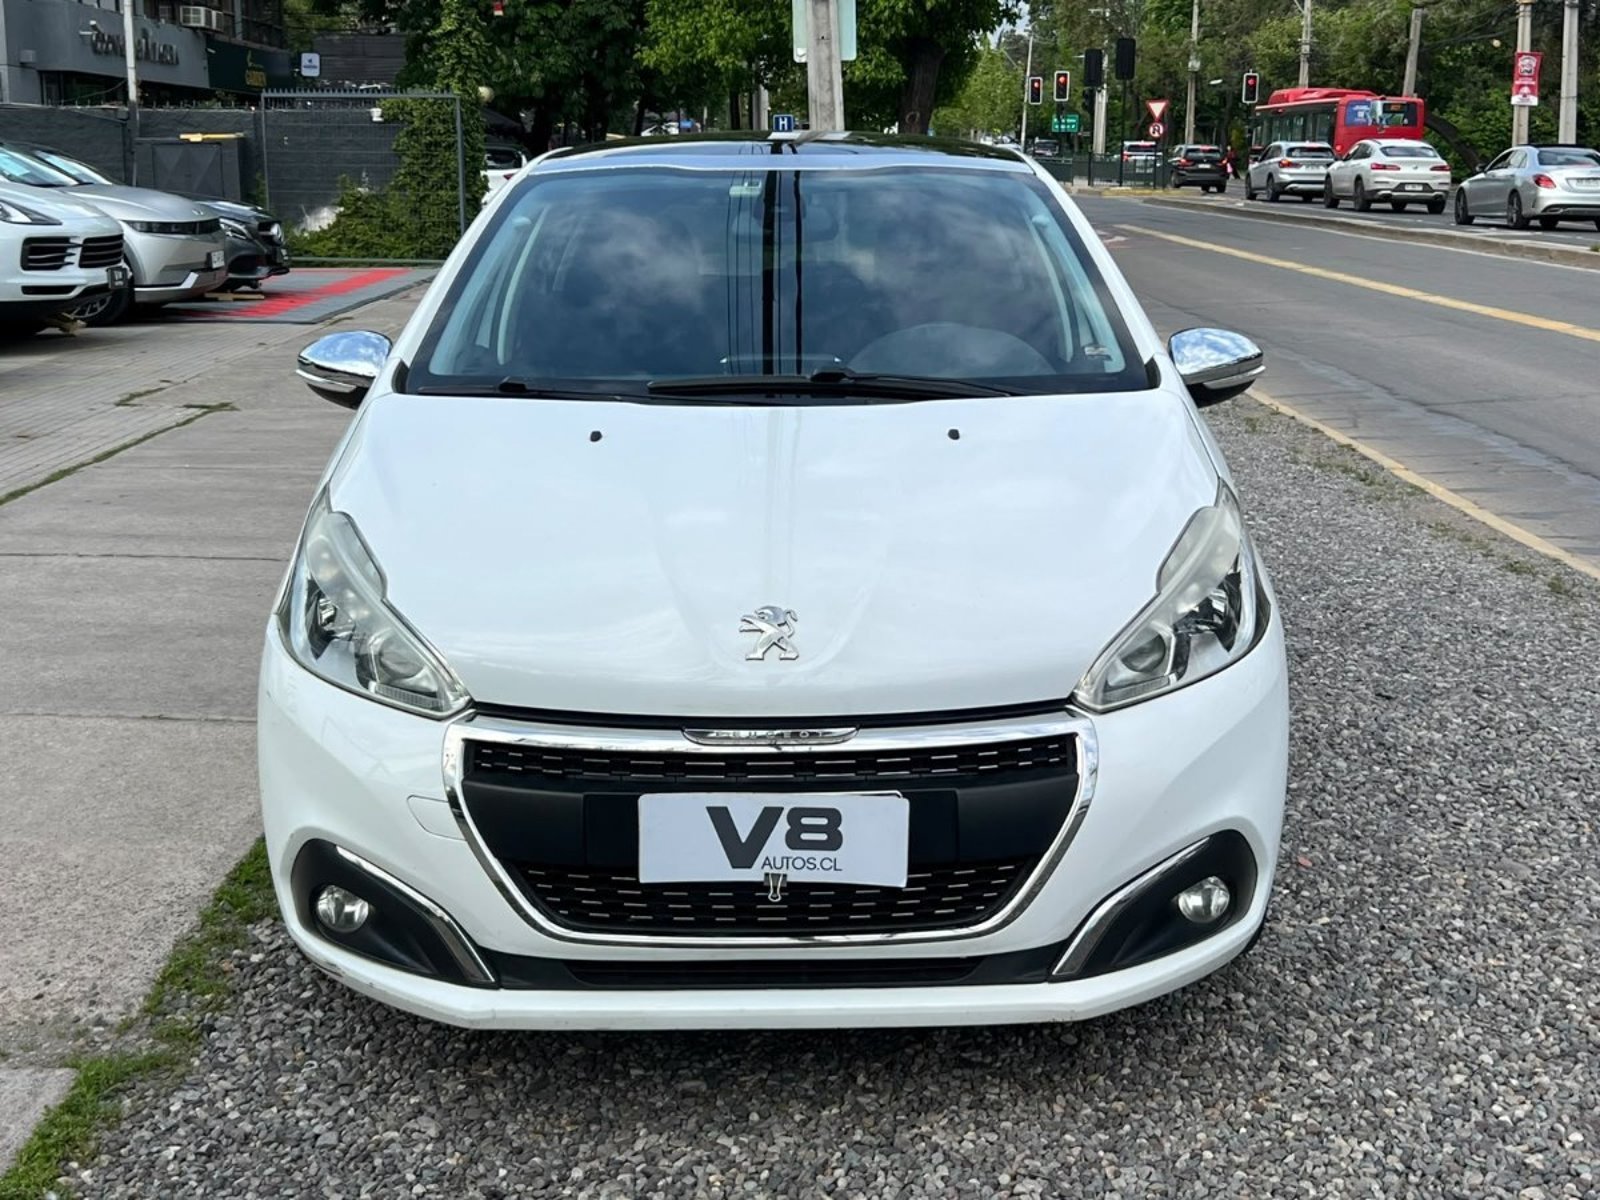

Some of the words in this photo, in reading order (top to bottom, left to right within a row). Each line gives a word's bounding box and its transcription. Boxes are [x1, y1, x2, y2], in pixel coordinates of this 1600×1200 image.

[778, 117, 788, 130] H
[706, 806, 843, 869] V8
[761, 856, 843, 872] AUTOS.CL
